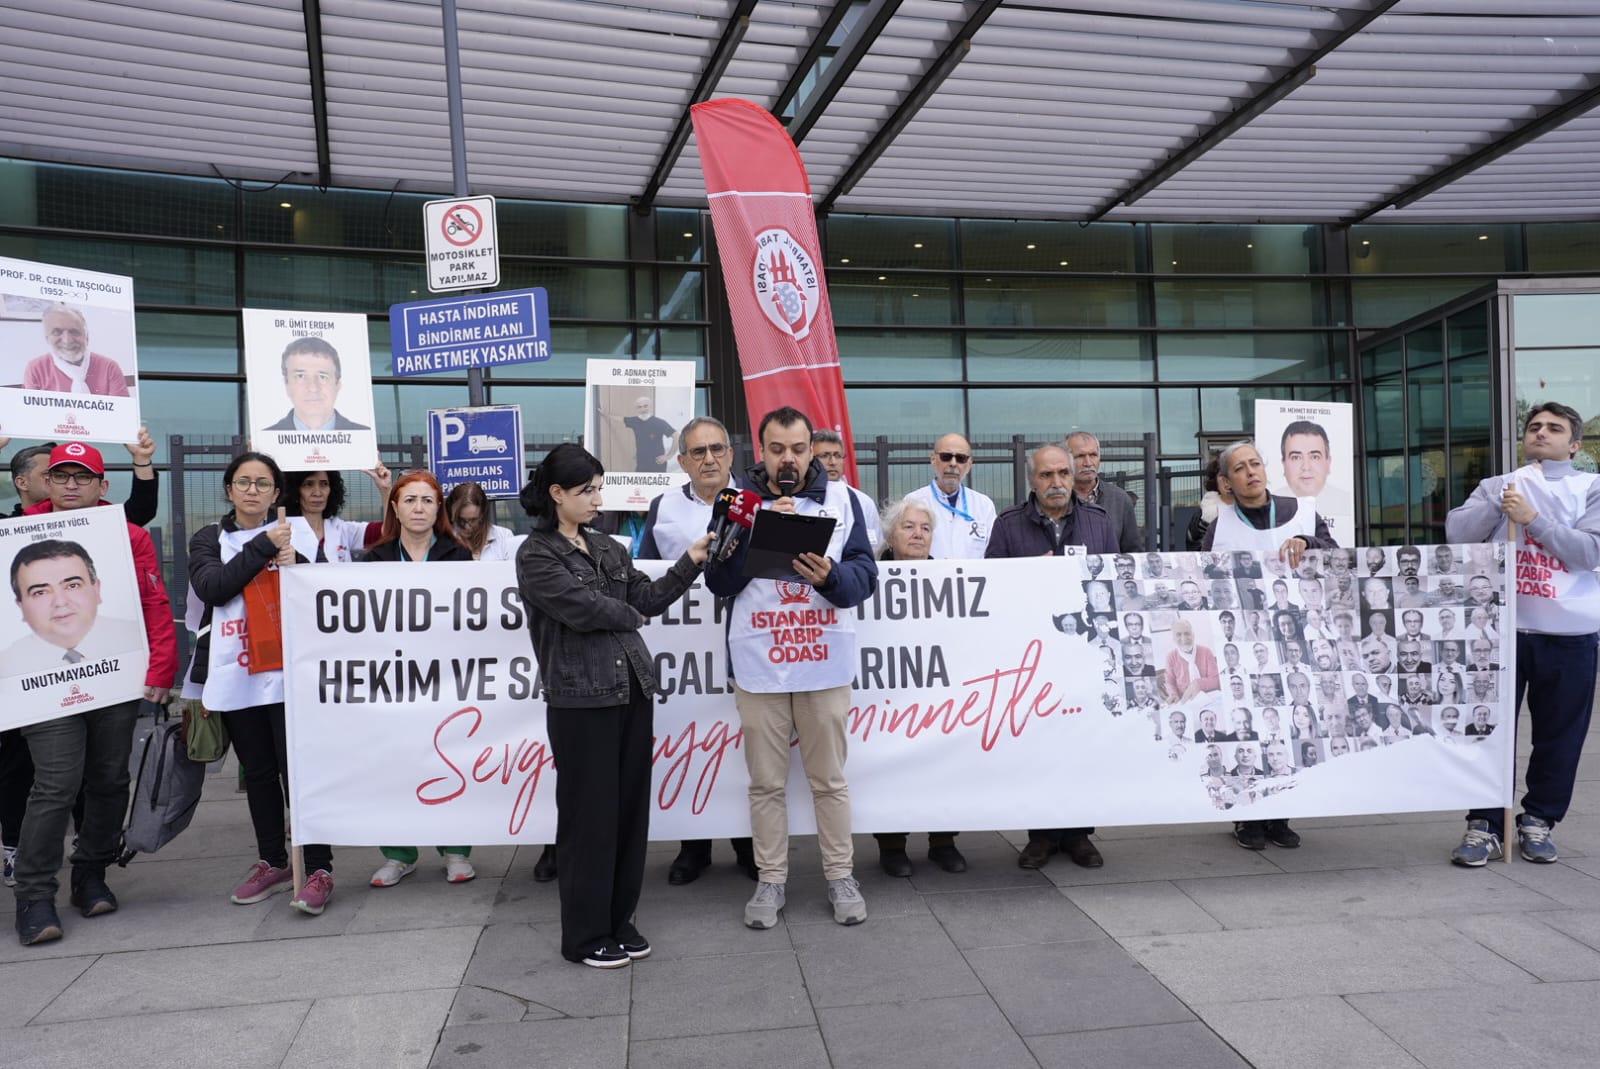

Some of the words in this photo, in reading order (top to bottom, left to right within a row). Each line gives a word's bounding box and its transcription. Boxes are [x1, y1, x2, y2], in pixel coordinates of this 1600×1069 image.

[430, 247, 493, 261] MOTOSİKLET
[449, 261, 476, 272] PARK
[0, 268, 27, 281] PROF.
[29, 273, 45, 283] DR.
[46, 275, 74, 287] CEMİL
[419, 309, 462, 326] HASTA
[463, 302, 519, 321] İNDİRME
[274, 319, 288, 328] DR.
[288, 318, 308, 329] ÜMİT
[309, 320, 335, 330] ERDEM
[418, 326, 481, 346] BİNDİRME
[483, 321, 524, 338] ALANI
[397, 354, 432, 374] PARK
[434, 347, 480, 369] ETMEK
[480, 340, 548, 365] YASAKTIR
[624, 368, 647, 377] ADNAN
[23, 395, 114, 412] UNUTMAYACAĞIZ
[278, 432, 352, 445] UNUTMAYACAĞIZ
[439, 416, 466, 457] P
[447, 465, 503, 478] AMBULANS
[605, 474, 671, 486] UNUTMAYACAĞIZ
[14, 523, 45, 535] MEHMET
[46, 520, 66, 530] RIFAT
[66, 517, 90, 527] YÜCEL
[316, 587, 488, 634] COVID-19
[768, 644, 829, 664] ODASI
[21, 659, 121, 692] UNUTMAYACAĞIZ
[318, 649, 440, 704] HEKİM
[451, 657, 498, 701] VE
[416, 706, 557, 835] Sevg
